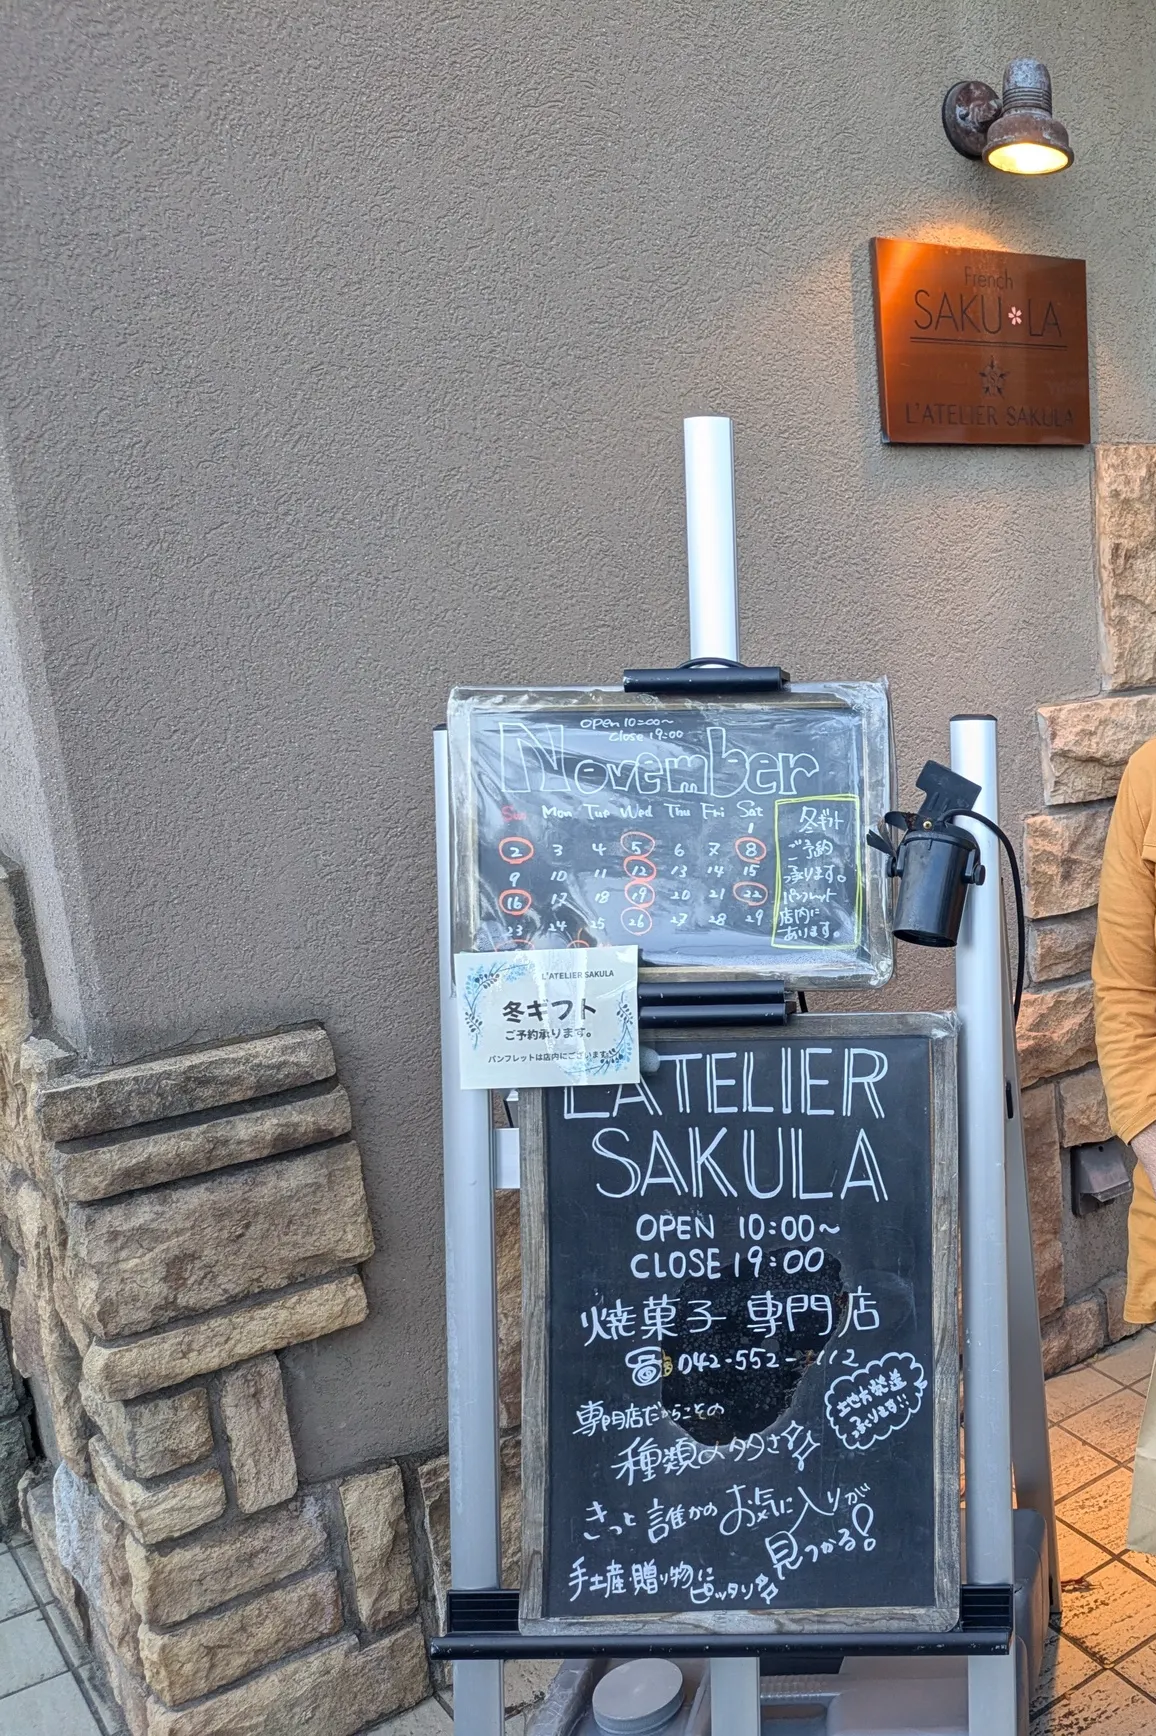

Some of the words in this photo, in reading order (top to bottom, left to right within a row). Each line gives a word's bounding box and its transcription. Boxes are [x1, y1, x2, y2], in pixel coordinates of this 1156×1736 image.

[964, 266, 1014, 290] French
[906, 403, 998, 425] L'ATELIER
[1006, 407, 1074, 428] SAKULA
[498, 721, 820, 798] November
[542, 805, 573, 819] Mon
[583, 803, 611, 820] Tue
[620, 804, 654, 819] Wed
[664, 803, 691, 818] Thu
[700, 802, 725, 820] Fri
[736, 800, 764, 818] Sat
[509, 847, 523, 858] 2
[552, 844, 564, 857] 3
[592, 843, 607, 857] 4
[631, 842, 643, 855] 5
[674, 843, 685, 857] 6
[745, 842, 758, 858] 8
[509, 872, 521, 887] 9
[550, 871, 568, 882] 10
[594, 869, 607, 879] 11
[632, 866, 648, 877] 12
[670, 866, 688, 878] 13
[707, 866, 725, 878] 14
[743, 865, 760, 877] 15
[507, 897, 523, 910] 16
[595, 891, 610, 904] 18
[632, 887, 647, 903] 19
[708, 888, 726, 900] 21
[743, 890, 763, 899] 22
[507, 925, 524, 937] 23
[548, 921, 568, 933] 24
[590, 918, 606, 930] 25
[628, 914, 645, 929] 26
[670, 913, 689, 927] 27
[708, 913, 728, 926] 28
[745, 909, 764, 926] 29
[780, 907, 820, 927] 店内に
[777, 921, 841, 942] あります。
[541, 972, 583, 981] L'ATELIER
[584, 970, 614, 979] SAKULA
[503, 998, 597, 1024] 冬ギフト
[505, 1027, 592, 1041] ご予約承ります。
[564, 1047, 889, 1119] LATELIER
[592, 1127, 888, 1202] SAKULA
[636, 1213, 715, 1242] OPEN
[630, 1248, 721, 1280] CLOSE
[734, 1246, 825, 1276] 19:00
